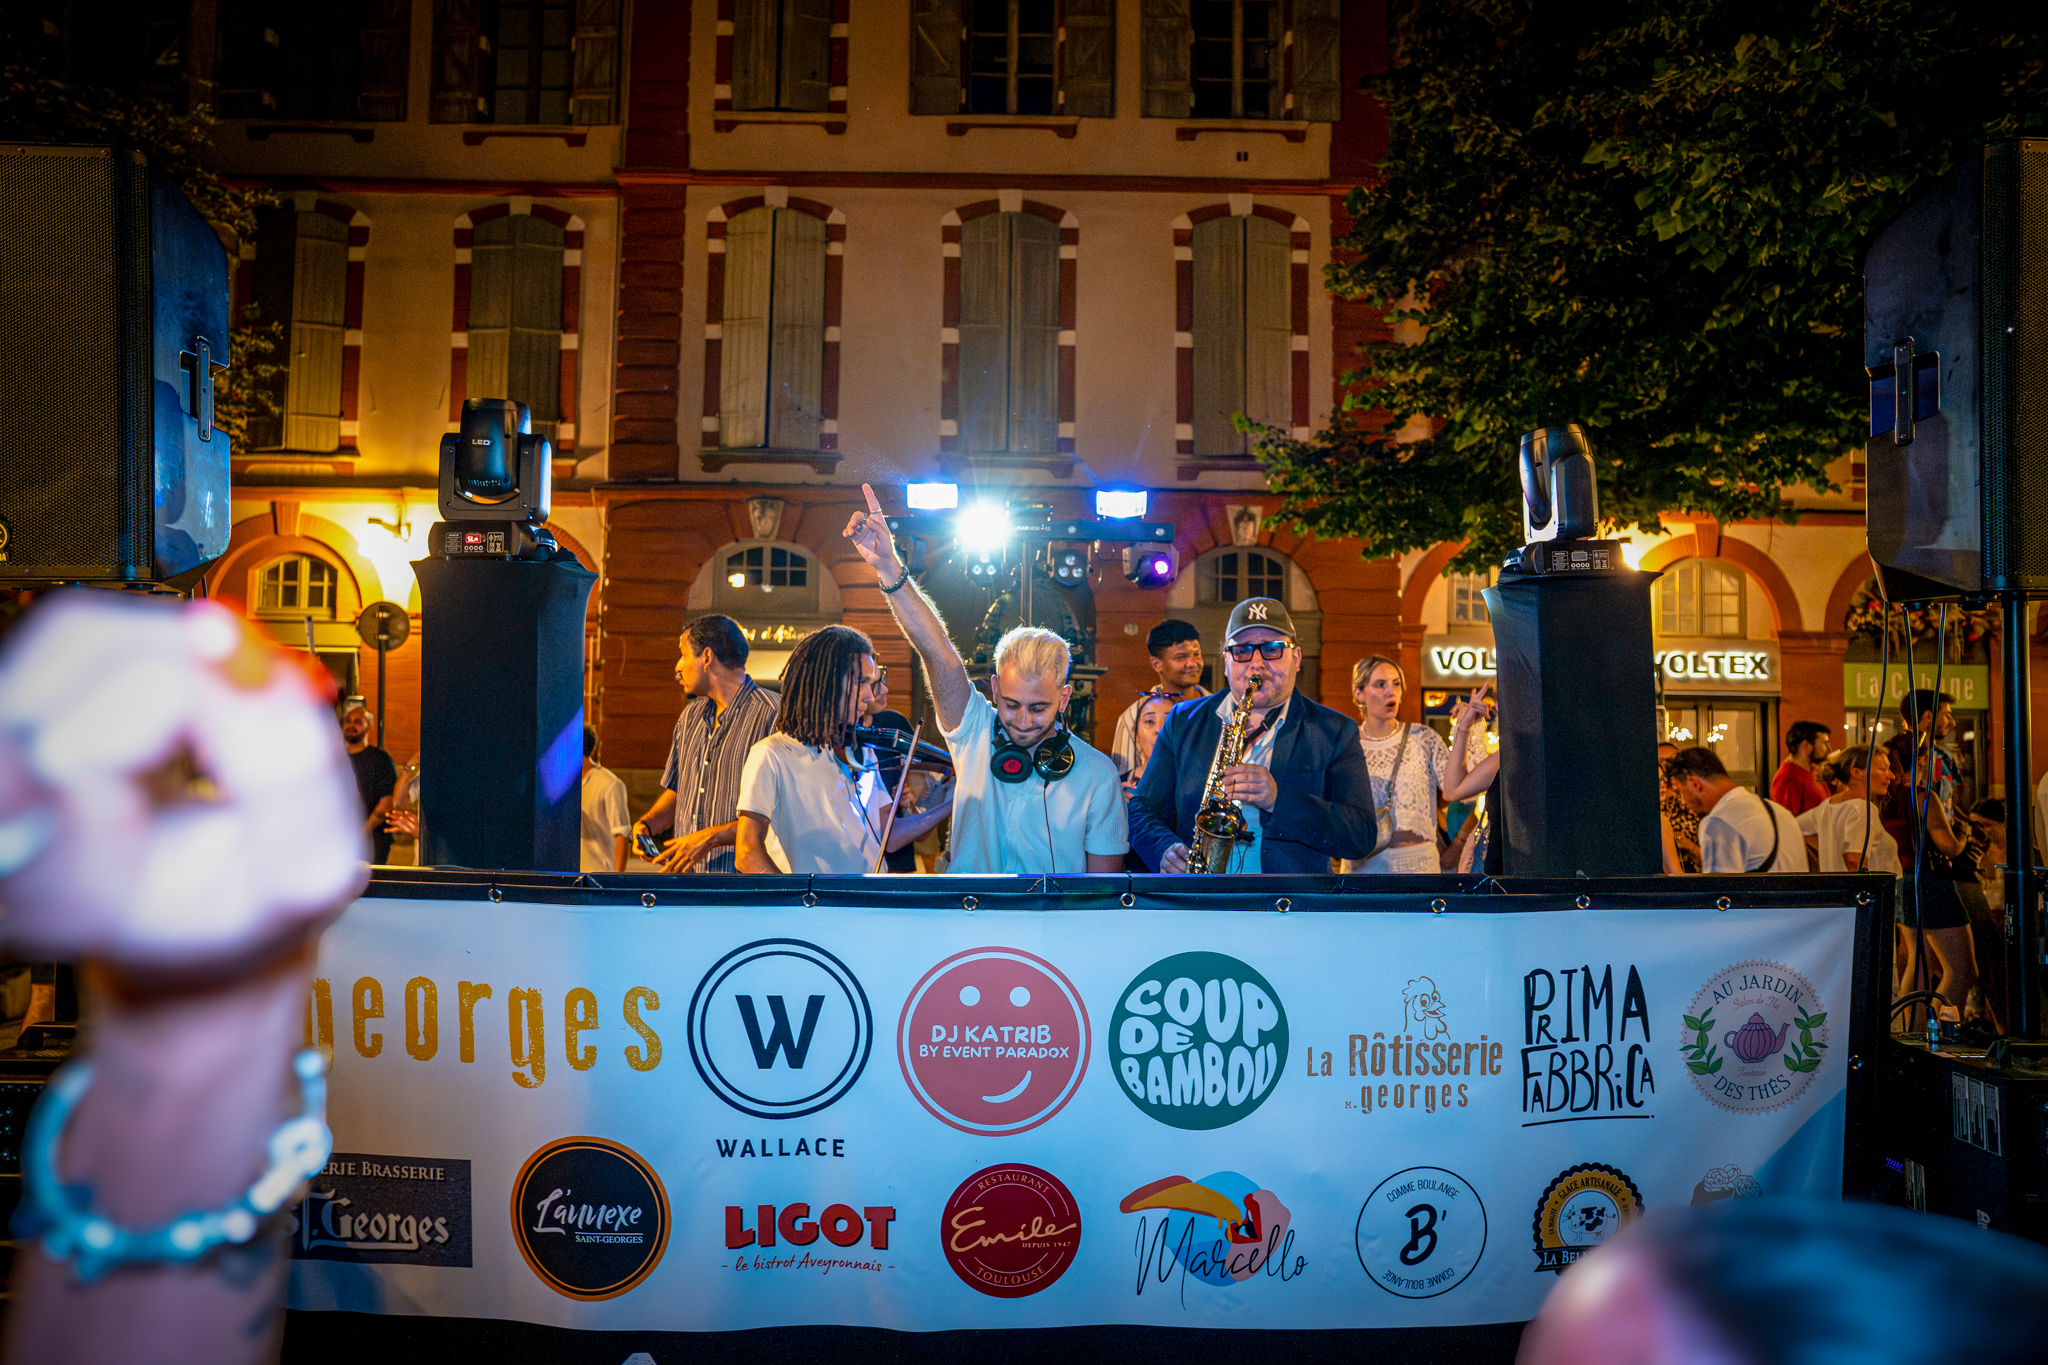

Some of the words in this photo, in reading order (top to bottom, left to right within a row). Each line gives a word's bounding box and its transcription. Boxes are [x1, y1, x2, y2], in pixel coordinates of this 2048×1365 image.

[1434, 649, 1497, 672] VOL
[1856, 672, 1879, 699] La
[1713, 980, 1733, 1005] AU
[1739, 974, 1804, 1004] JARDIN
[1124, 977, 1279, 1047] COUP
[1523, 964, 1651, 1045] PRIMA
[734, 994, 826, 1069] W
[931, 1025, 959, 1043] DJ
[965, 1025, 1051, 1043] KATRIB
[1119, 1016, 1194, 1054] DE
[919, 1045, 942, 1058] BY
[943, 1045, 991, 1058] EVENT
[996, 1045, 1069, 1059] PARADOX
[1307, 1047, 1332, 1076] La
[1349, 1032, 1503, 1076] Rôtisserie
[1120, 1042, 1277, 1106] BAMBOU
[1361, 1084, 1468, 1114] georges
[1714, 1075, 1744, 1100] DES
[1748, 1074, 1791, 1101] THÉS
[716, 1138, 845, 1157] WALLACE
[321, 1162, 356, 1176] ERIE
[977, 1173, 1050, 1193] RESTAURANT
[1386, 1181, 1416, 1202] COMME
[1418, 1179, 1460, 1200] BOULANGE
[1558, 1180, 1580, 1199] GLACE
[1581, 1177, 1622, 1197] ARTISANALE
[725, 1202, 896, 1250] LIGOT
[951, 1206, 1077, 1252] Emile
[575, 1235, 643, 1244] SAINT-GEORGES
[736, 1256, 749, 1271] le
[754, 1254, 795, 1270] bistrot
[797, 1252, 882, 1275] Aveyronnais
[977, 1266, 1045, 1284] TOULOUSE
[1135, 1216, 1309, 1311] Marcello
[1382, 1269, 1424, 1289] BOULANGE
[1427, 1267, 1455, 1288] COMME
